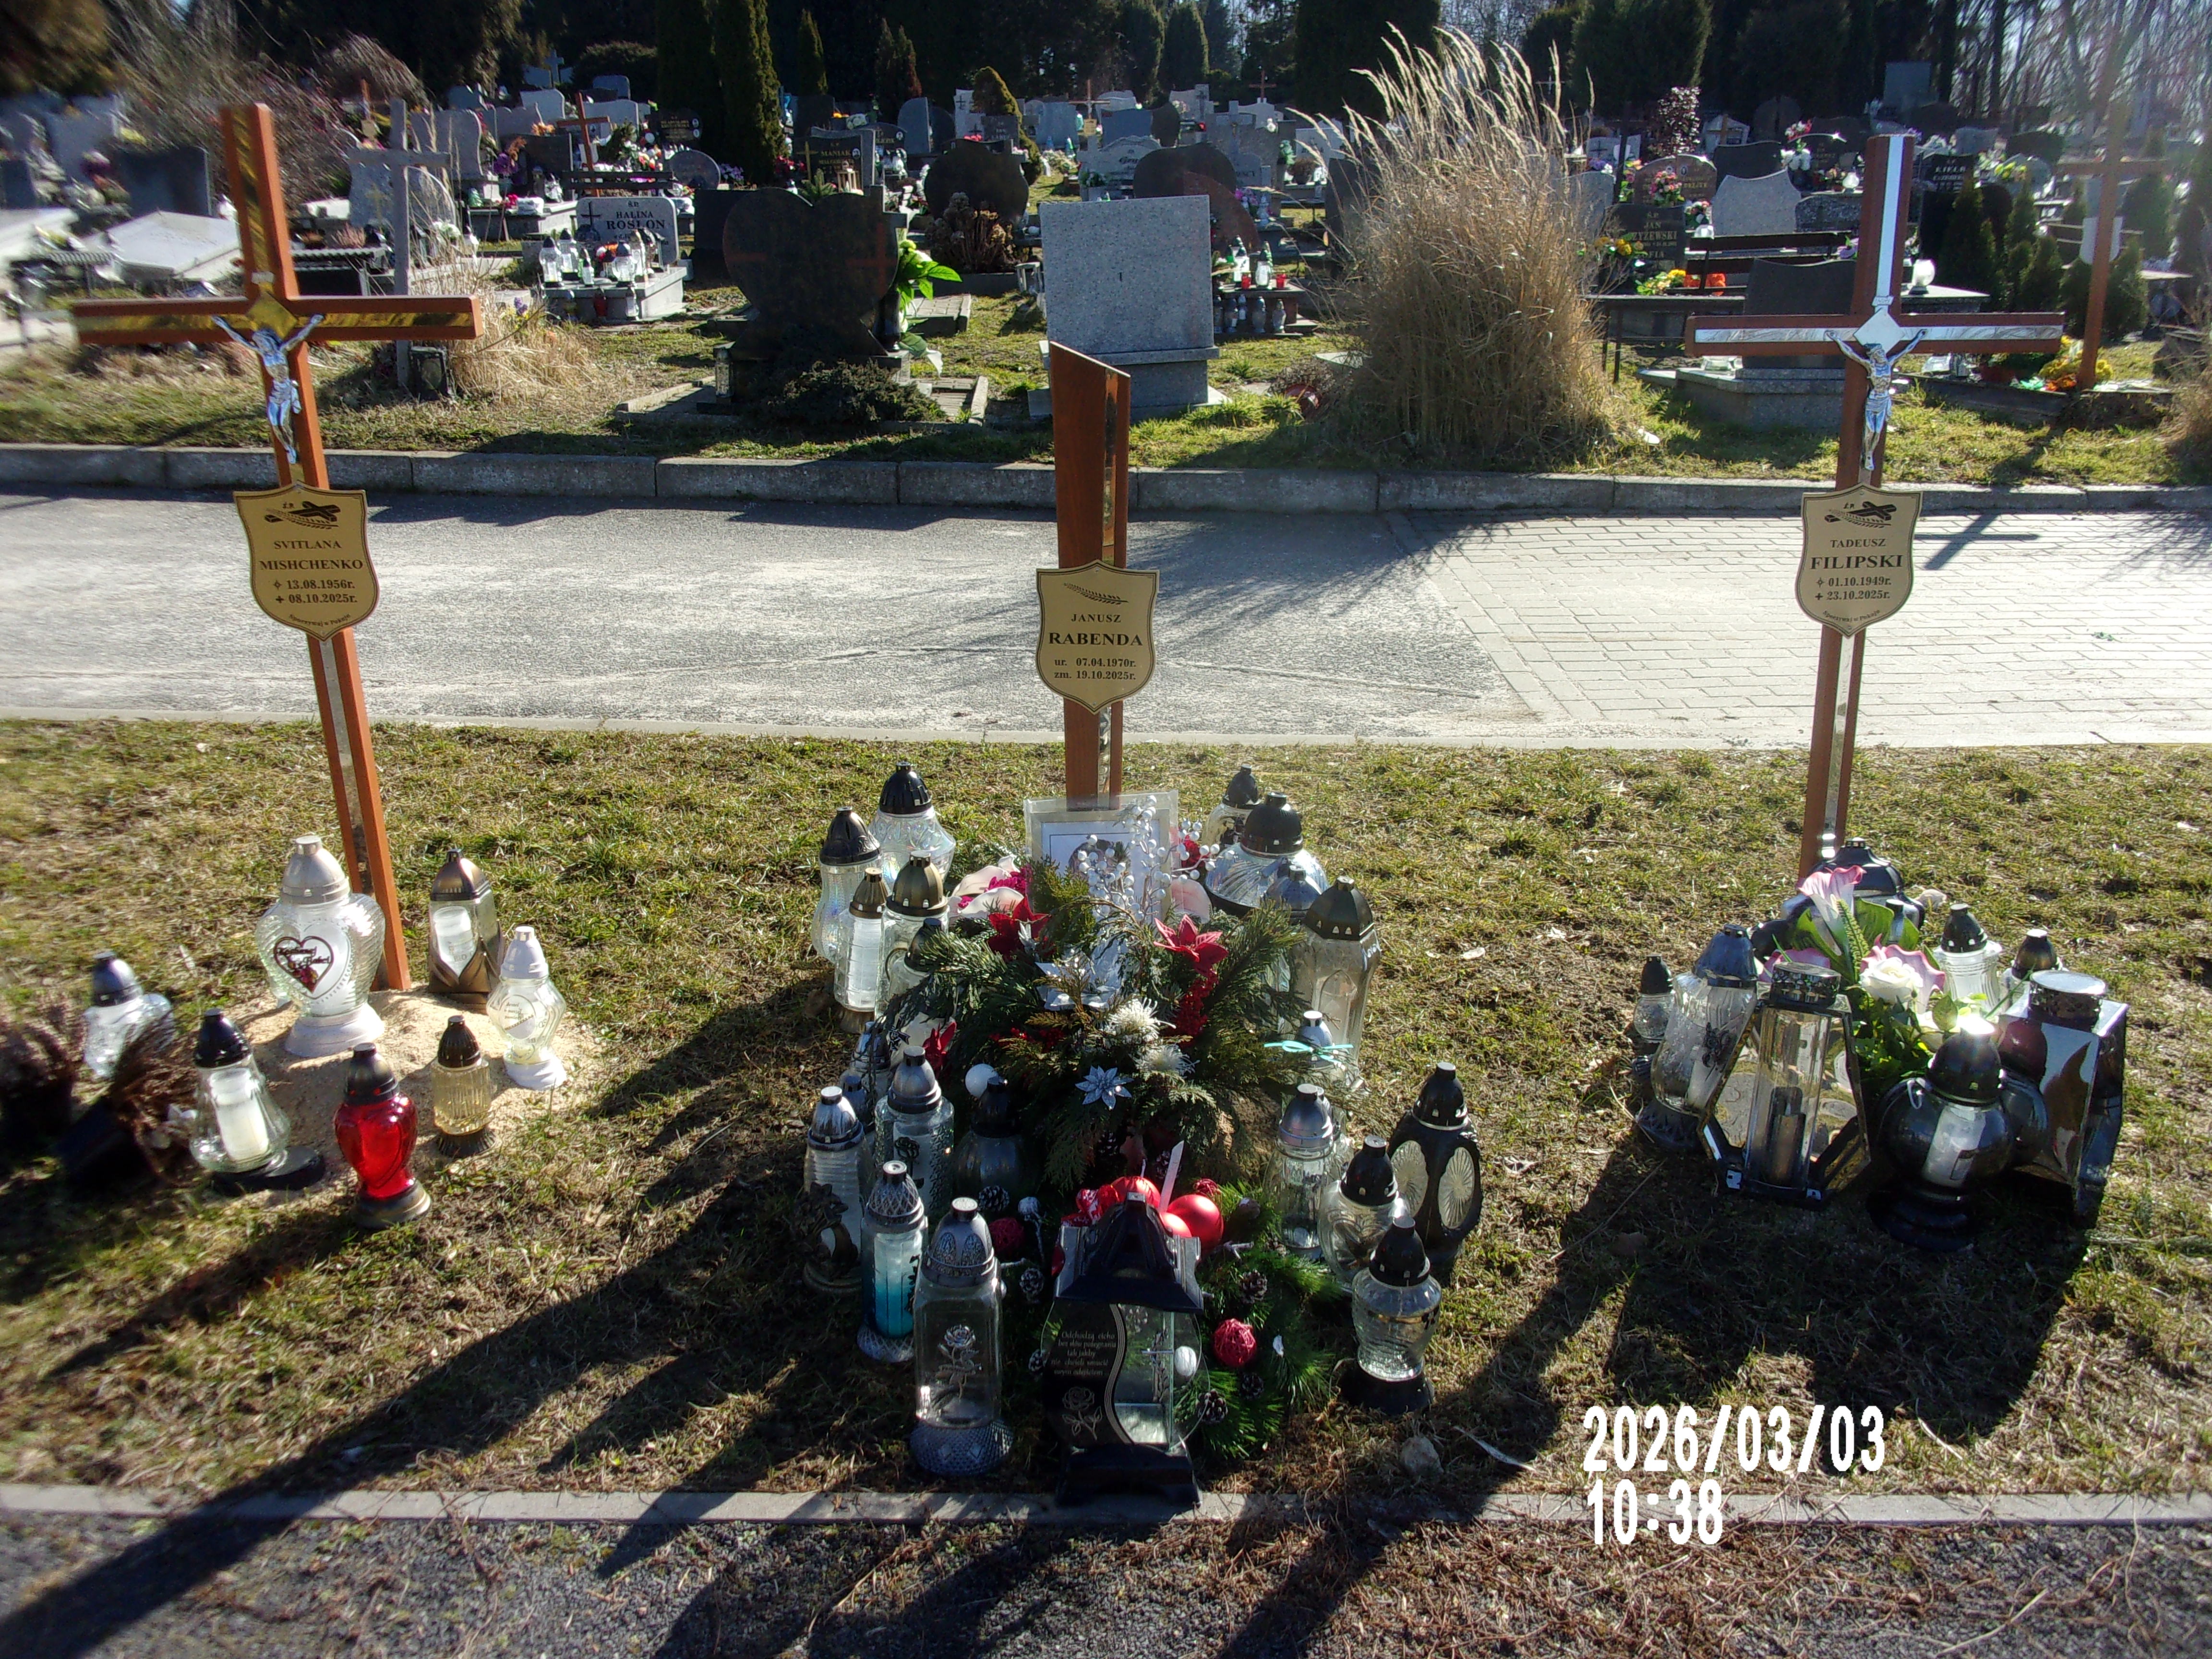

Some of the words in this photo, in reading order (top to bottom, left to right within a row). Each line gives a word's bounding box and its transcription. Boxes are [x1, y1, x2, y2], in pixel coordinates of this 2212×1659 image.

[616, 211, 654, 219] HALINA
[274, 540, 342, 550] SVITLANA
[1830, 539, 1886, 548] TADEUSZ
[259, 559, 363, 570] MISHCHENKO
[1810, 555, 1904, 569] FILIPSKI
[287, 580, 355, 589] 13.08.1956r.
[1828, 577, 1892, 587] 01.10.1949r.
[289, 593, 358, 603] 08.10.2025r.
[1827, 590, 1890, 601] 23.10.2025r.
[1071, 613, 1121, 623] JANUSZ
[1049, 632, 1143, 646] RABENDA
[1076, 658, 1136, 667] 07.04.1970r.
[1076, 670, 1136, 680] 19.10.2025r.
